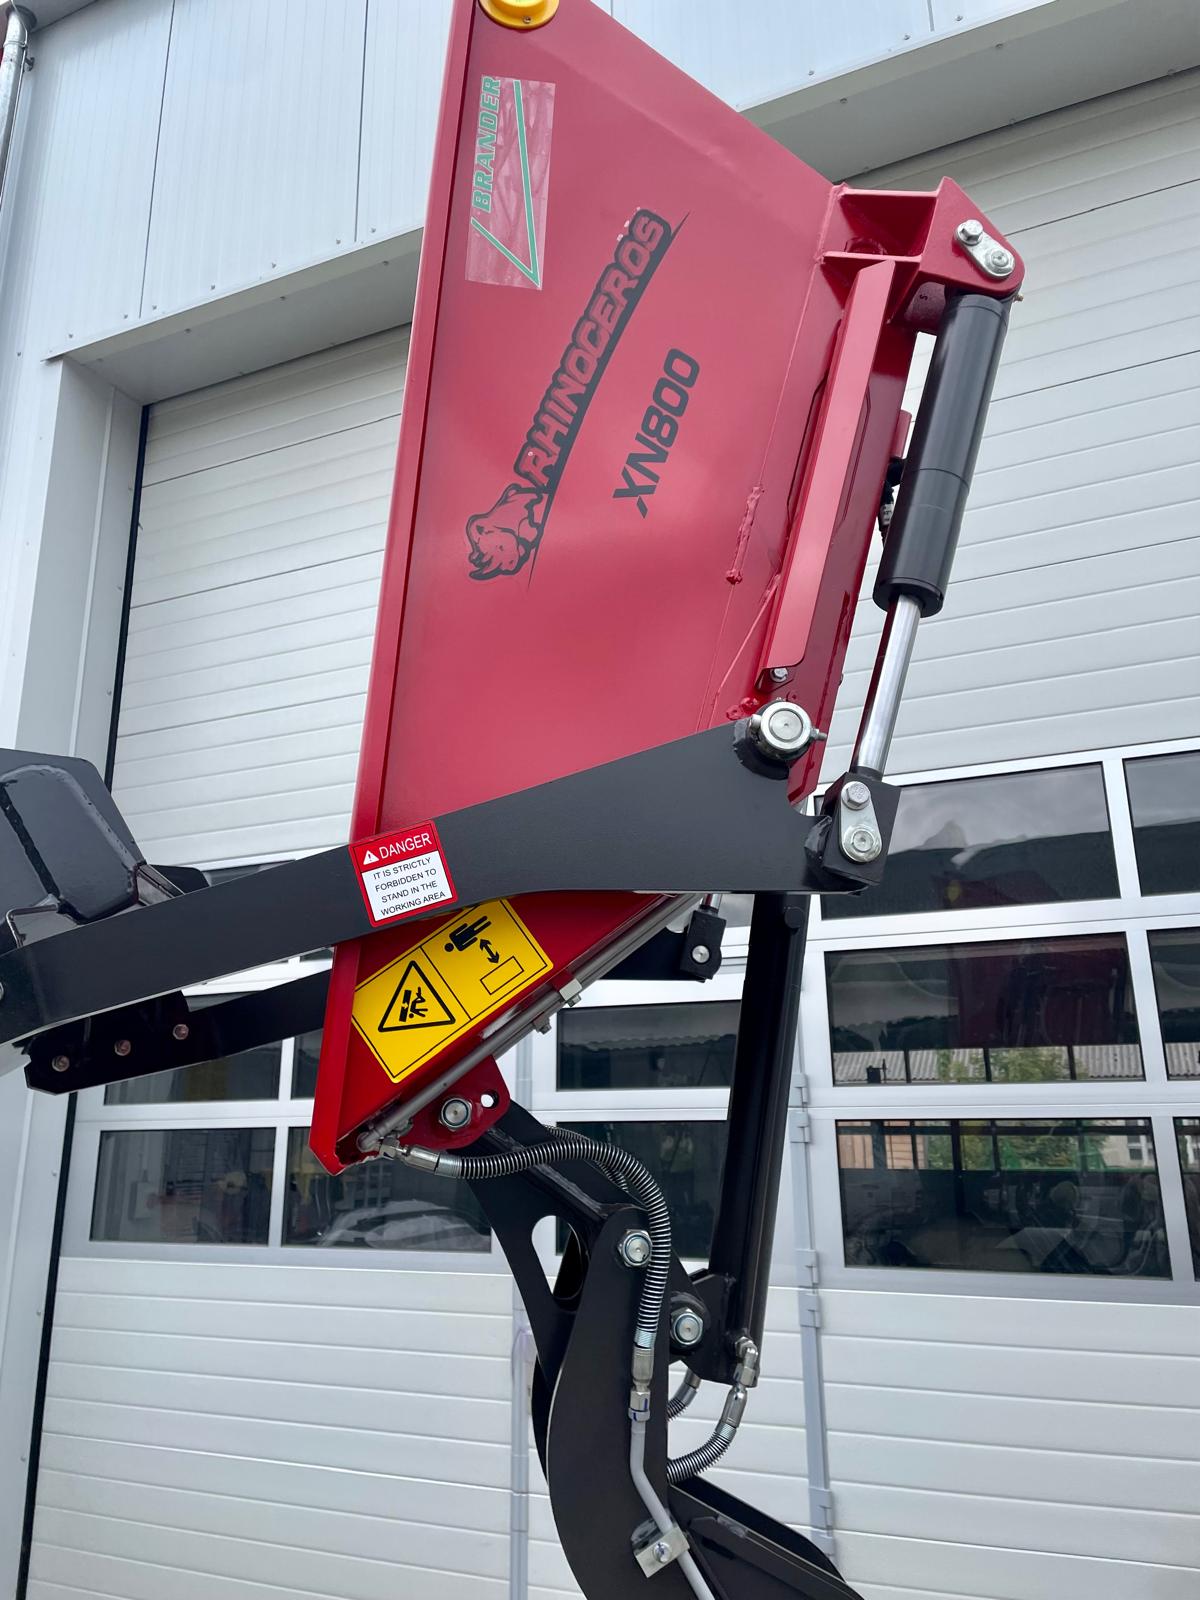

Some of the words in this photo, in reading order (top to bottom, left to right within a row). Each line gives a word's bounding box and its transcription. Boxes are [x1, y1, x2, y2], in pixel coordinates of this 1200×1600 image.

[472, 75, 501, 213] BRANDER
[514, 209, 671, 489] RHINOCEROS
[612, 348, 700, 519] XN800
[379, 832, 432, 859] DANGER
[373, 871, 381, 880] IT
[382, 869, 391, 877] IS
[392, 857, 431, 874] STRICTLY
[374, 872, 424, 892] FORBIDDEN
[424, 868, 437, 876] TO
[380, 898, 422, 916] WORKING
[423, 891, 446, 903] AREA
[381, 889, 409, 903] STAND
[410, 886, 419, 894] IN
[420, 880, 438, 890] THE
